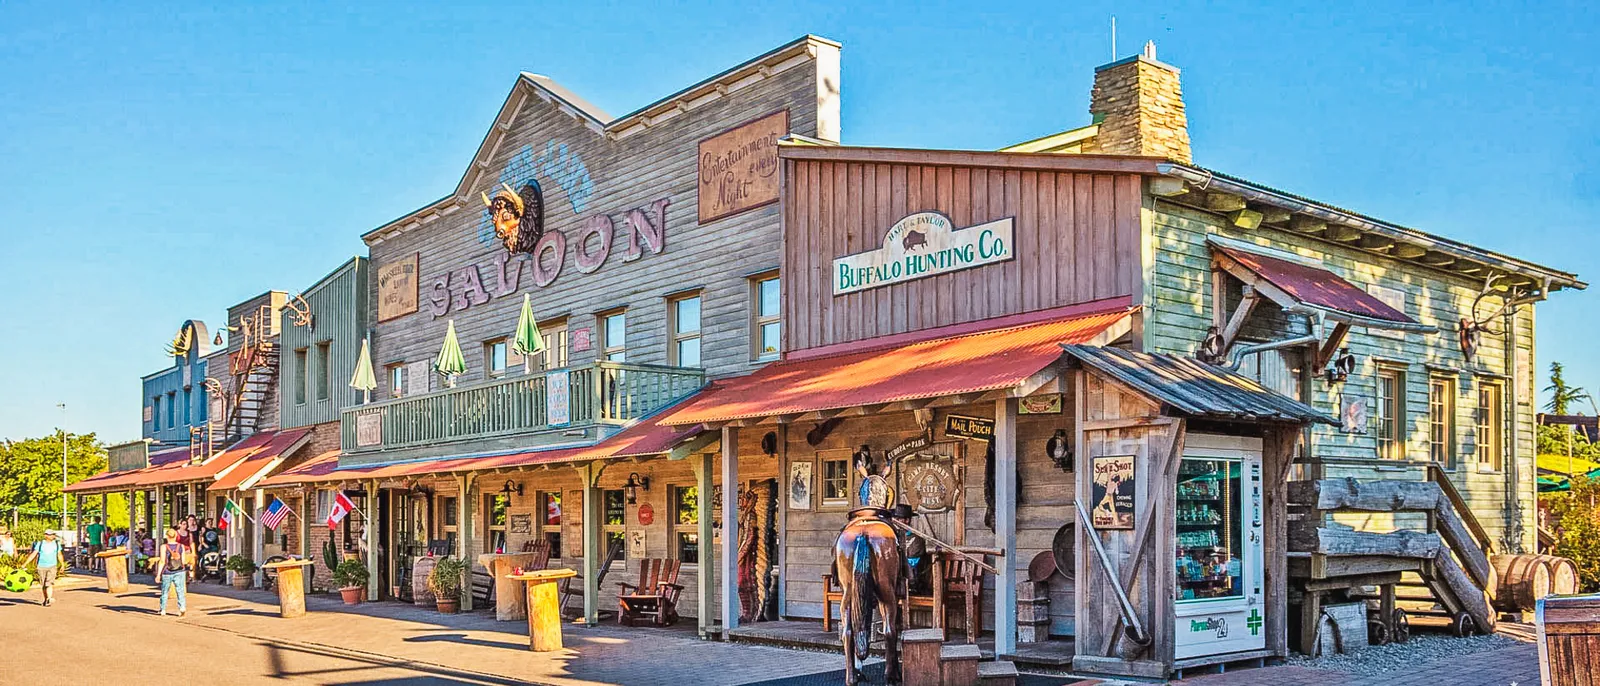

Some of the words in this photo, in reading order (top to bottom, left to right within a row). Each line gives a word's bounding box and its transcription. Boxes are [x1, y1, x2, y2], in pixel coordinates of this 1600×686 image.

[713, 171, 753, 210] Night
[917, 216, 945, 229] TAYLOR
[428, 199, 670, 320] SALOON
[839, 263, 901, 290] BUFFALO
[905, 244, 974, 276] HUNTING
[951, 418, 966, 431] MAIL
[969, 420, 991, 435] POUCH
[911, 439, 925, 448] PARK
[925, 462, 950, 480] RESORT
[1114, 460, 1132, 473] SHOT
